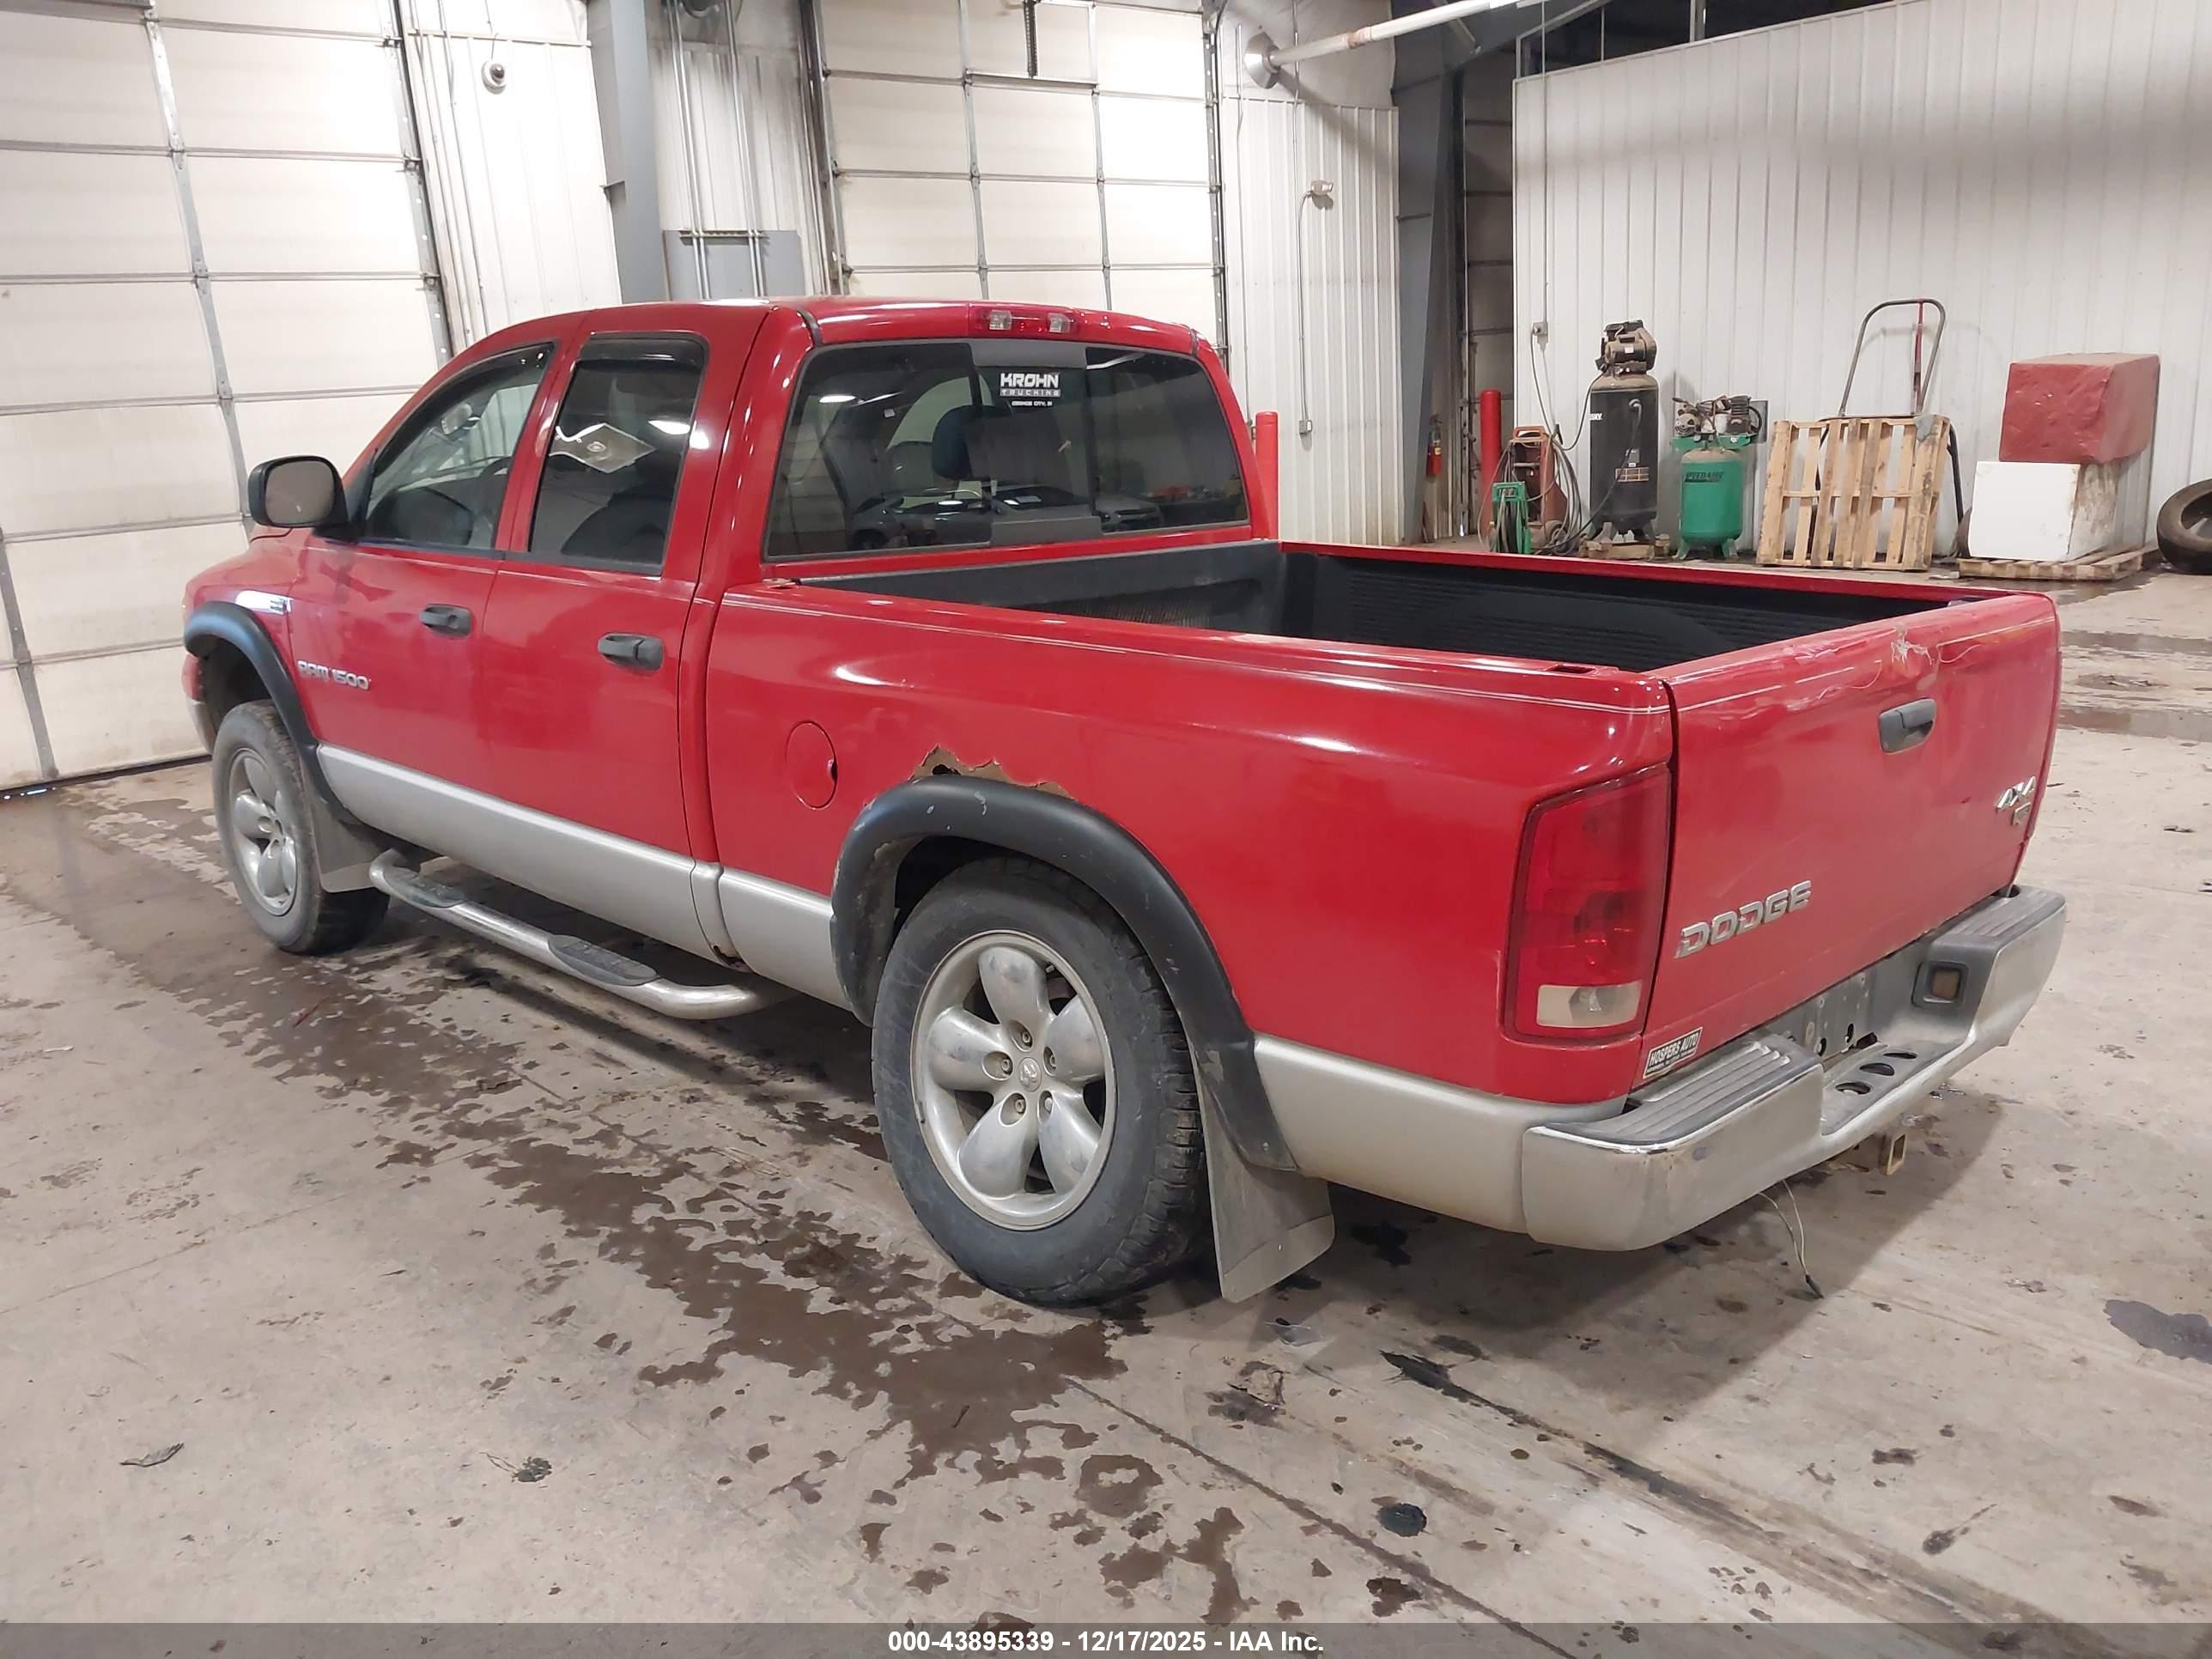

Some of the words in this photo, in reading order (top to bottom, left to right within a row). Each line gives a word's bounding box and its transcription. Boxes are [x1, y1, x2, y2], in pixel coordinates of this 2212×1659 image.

[1000, 373, 1059, 388] KROHN
[331, 669, 370, 690] 1500
[1674, 879, 1812, 958] DODGE
[1649, 1041, 1680, 1066] HOSPERS
[1680, 1032, 1699, 1052] AUTO
